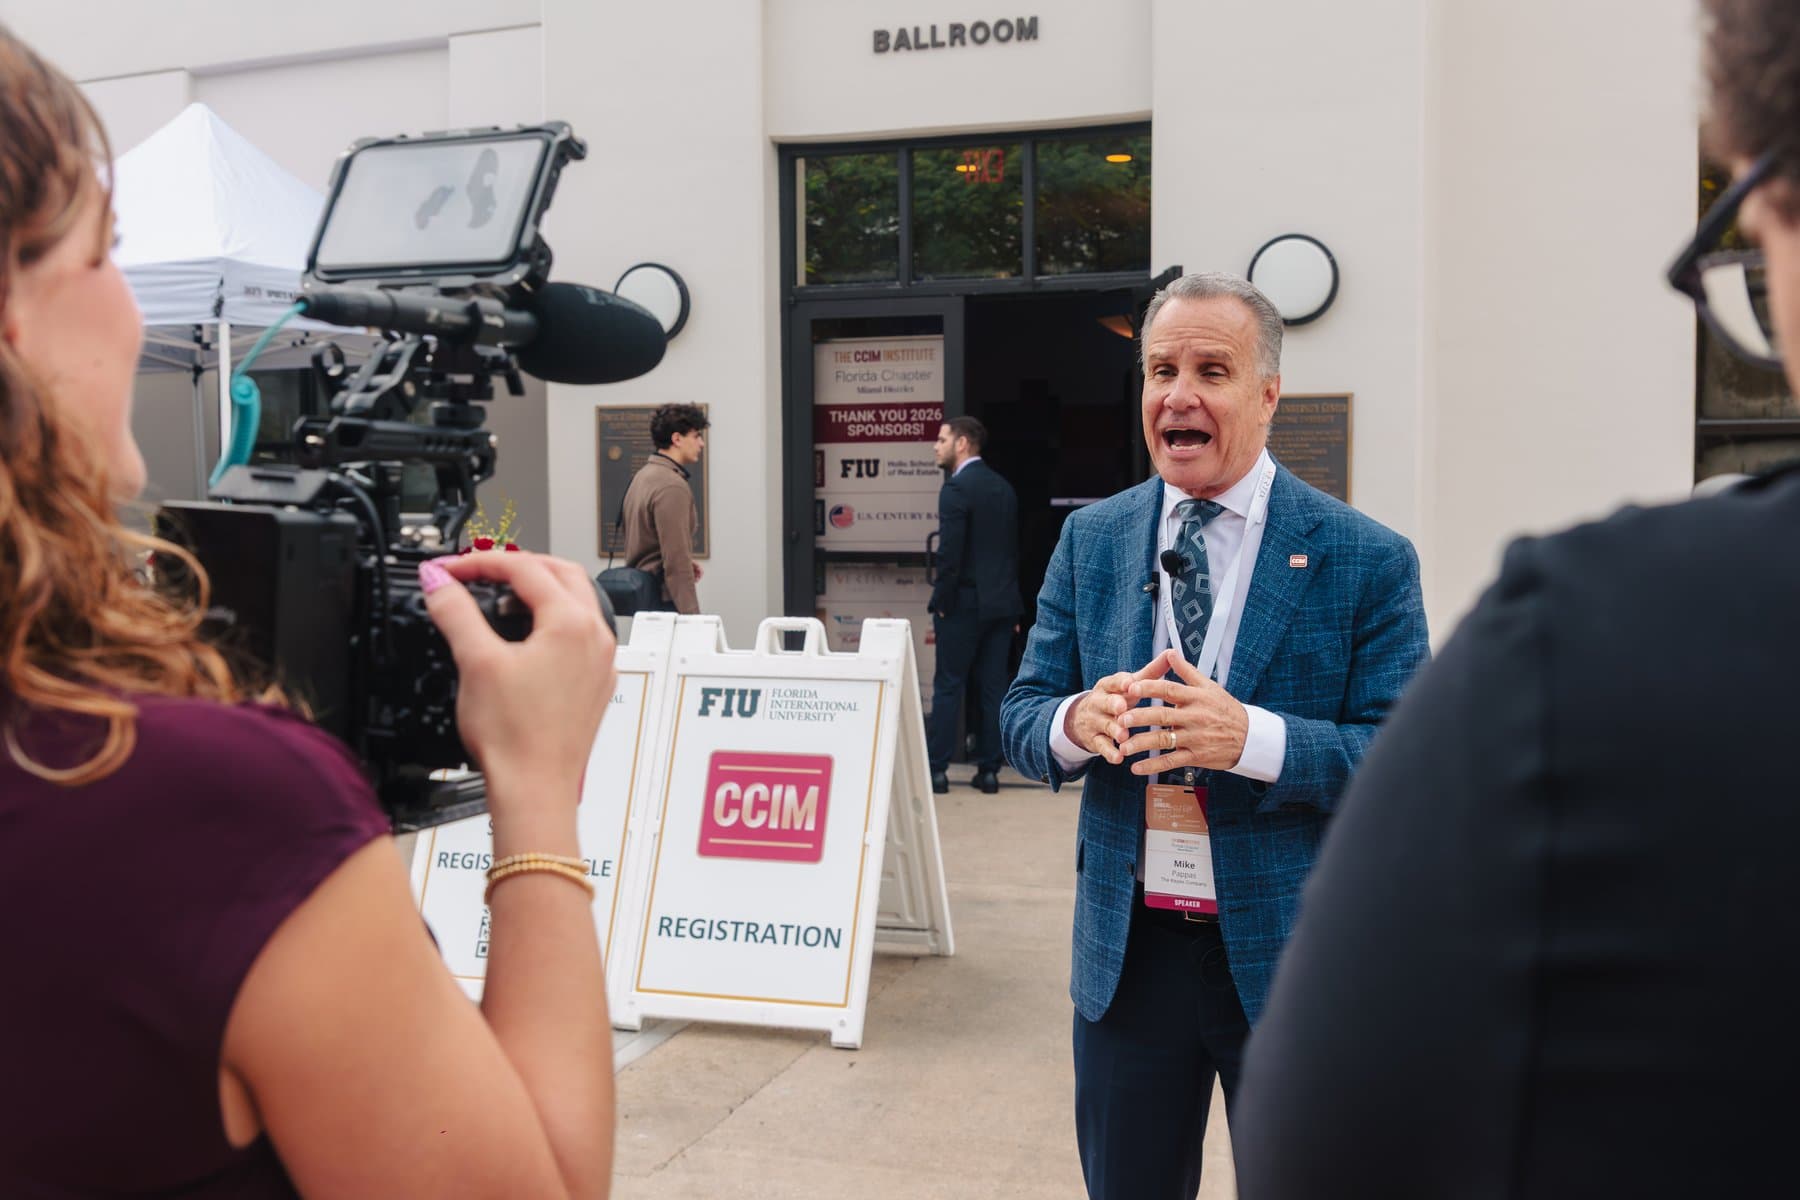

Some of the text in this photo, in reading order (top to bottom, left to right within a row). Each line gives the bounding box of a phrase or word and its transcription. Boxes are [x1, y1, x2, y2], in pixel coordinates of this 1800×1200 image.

[873, 16, 1039, 53] BALLROOM
[835, 348, 936, 363] THE CCIM INSTITUTE
[835, 369, 933, 382] Florida Chapter
[830, 407, 942, 423] THANK YOU 2026
[847, 423, 925, 437] SPONSORS!
[841, 459, 880, 478] FIU
[875, 511, 923, 520] CENTURY
[698, 687, 818, 718] FIU FLORIDA
[770, 700, 859, 712] INTERNATIONAL
[769, 711, 836, 723] UNIVERSITY
[713, 781, 820, 832] CCIM
[437, 852, 491, 870] REGIS
[1174, 860, 1196, 869] Mike
[1174, 899, 1201, 908] SPEAKER
[658, 916, 842, 948] REGISTRATION
